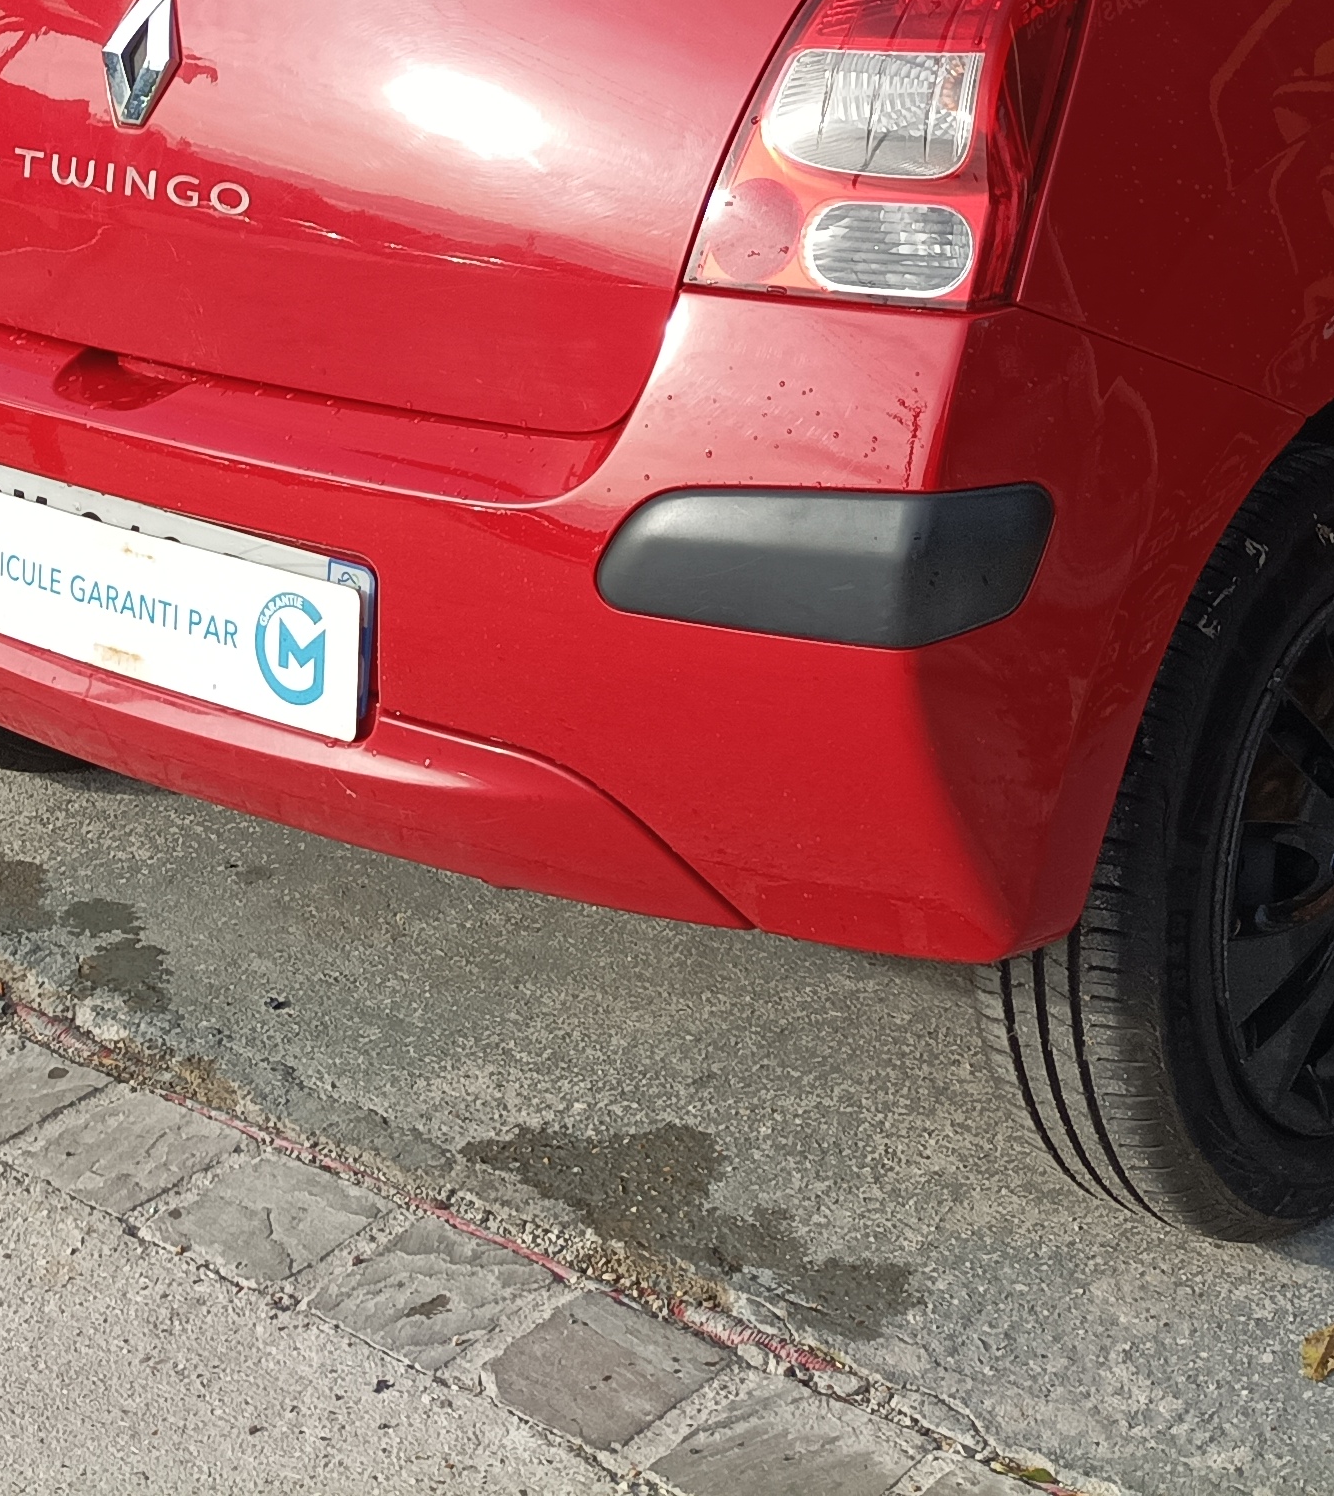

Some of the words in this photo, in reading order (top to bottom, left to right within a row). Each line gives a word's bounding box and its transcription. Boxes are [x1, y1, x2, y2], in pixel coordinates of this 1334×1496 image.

[14, 147, 251, 216] TWINGO
[70, 574, 179, 631] GARANTI
[188, 608, 238, 649] PAR
[259, 593, 305, 627] GARANTIE
